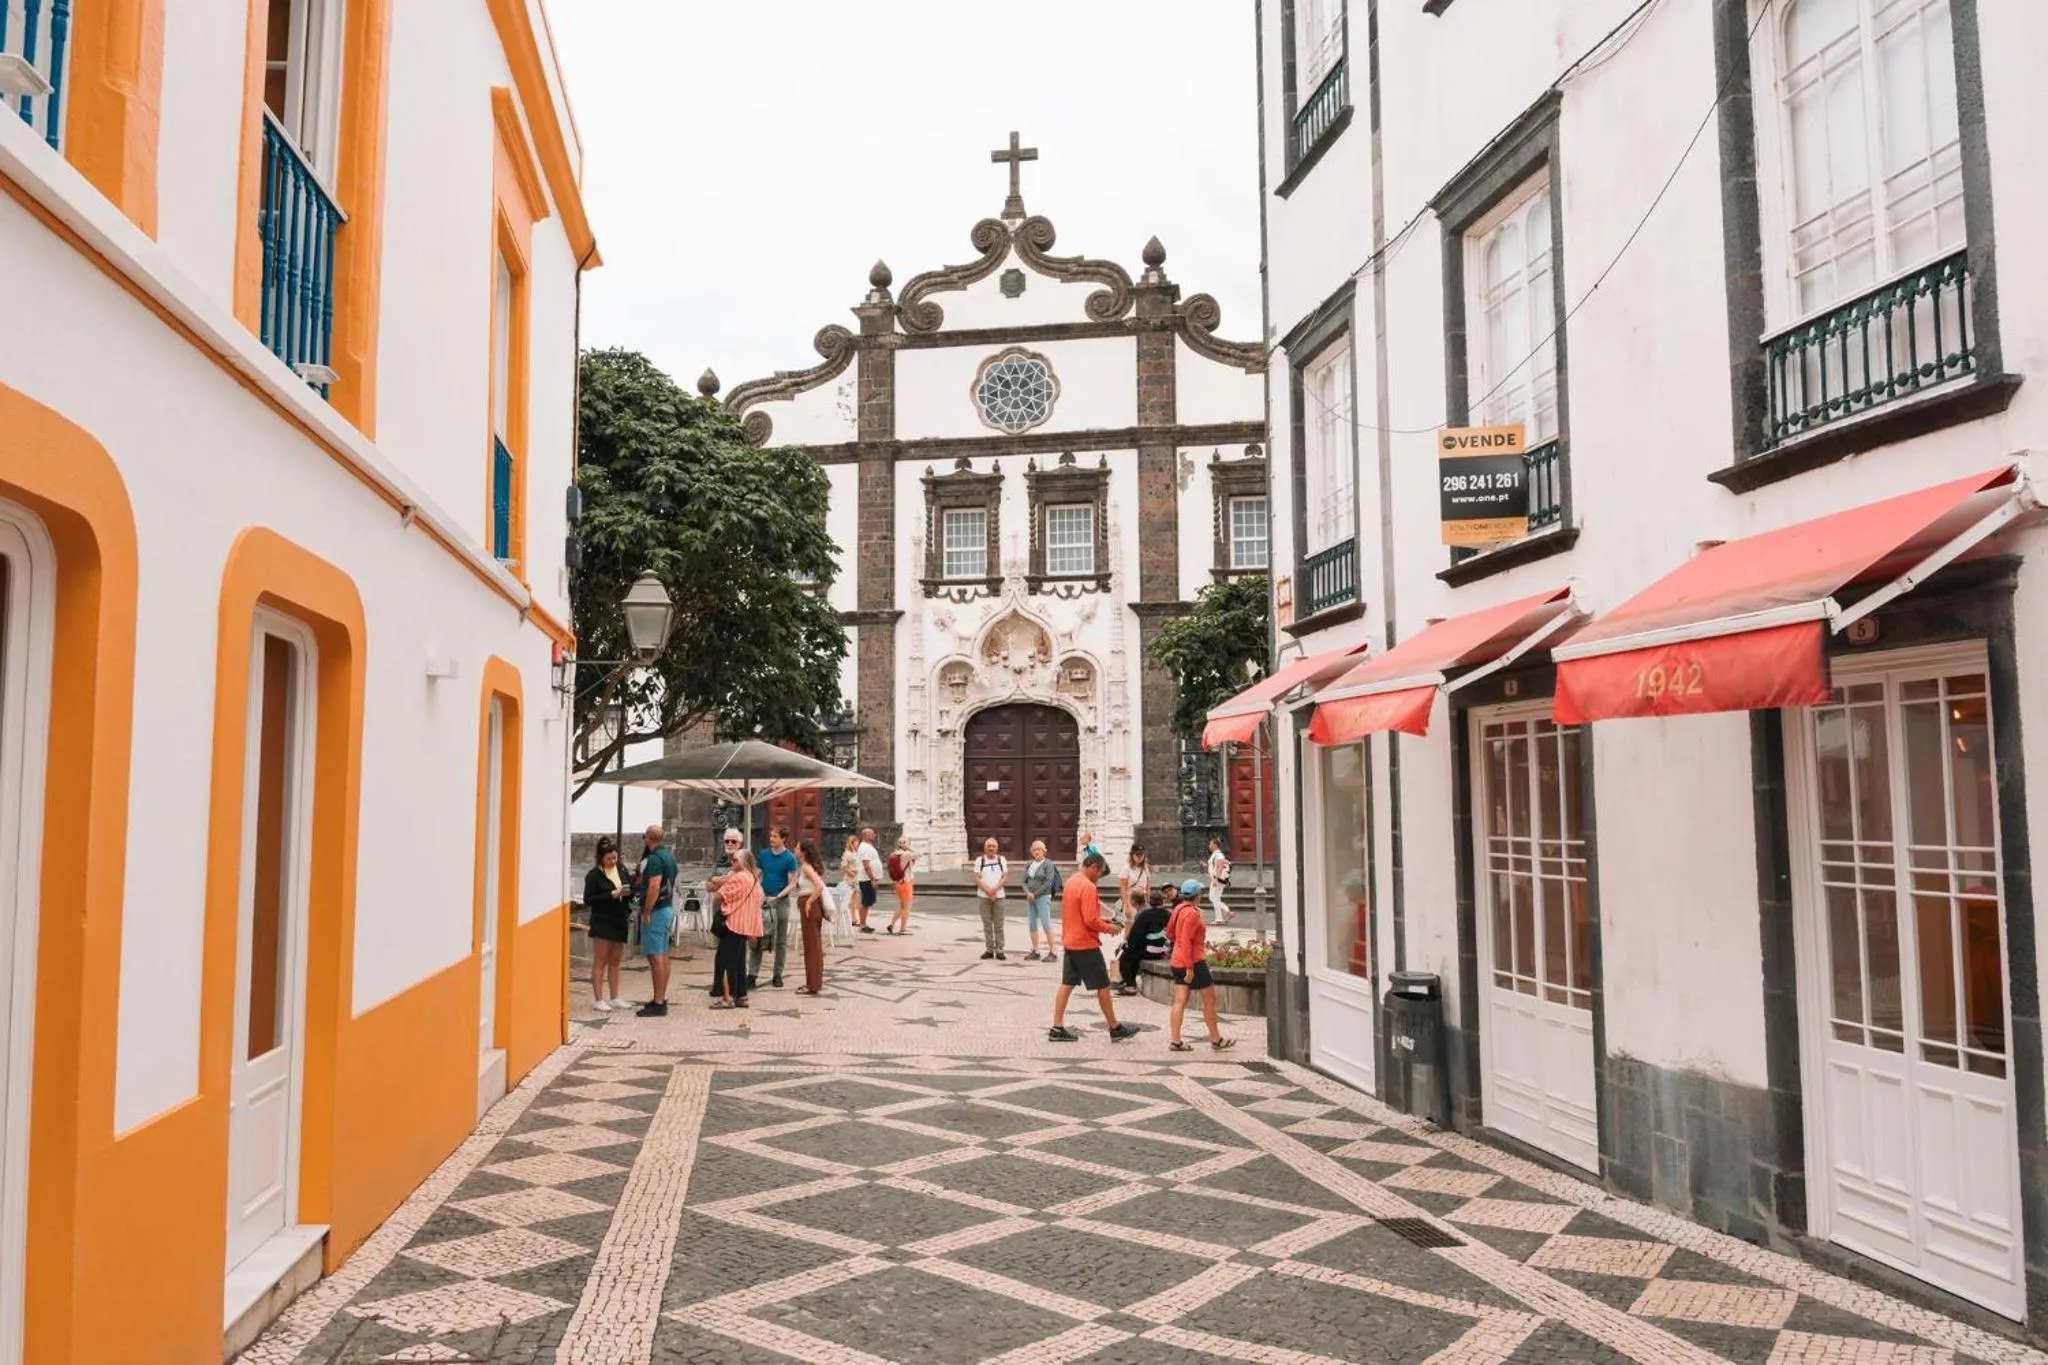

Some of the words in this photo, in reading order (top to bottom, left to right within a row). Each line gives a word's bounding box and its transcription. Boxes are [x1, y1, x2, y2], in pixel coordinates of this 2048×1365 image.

[1459, 434, 1516, 448] VENDE
[1443, 476, 1467, 491] 296
[1469, 474, 1493, 490] 241
[1451, 493, 1509, 503] www.one.pt
[1857, 622, 1866, 637] 5
[1636, 664, 1703, 700] 1942
